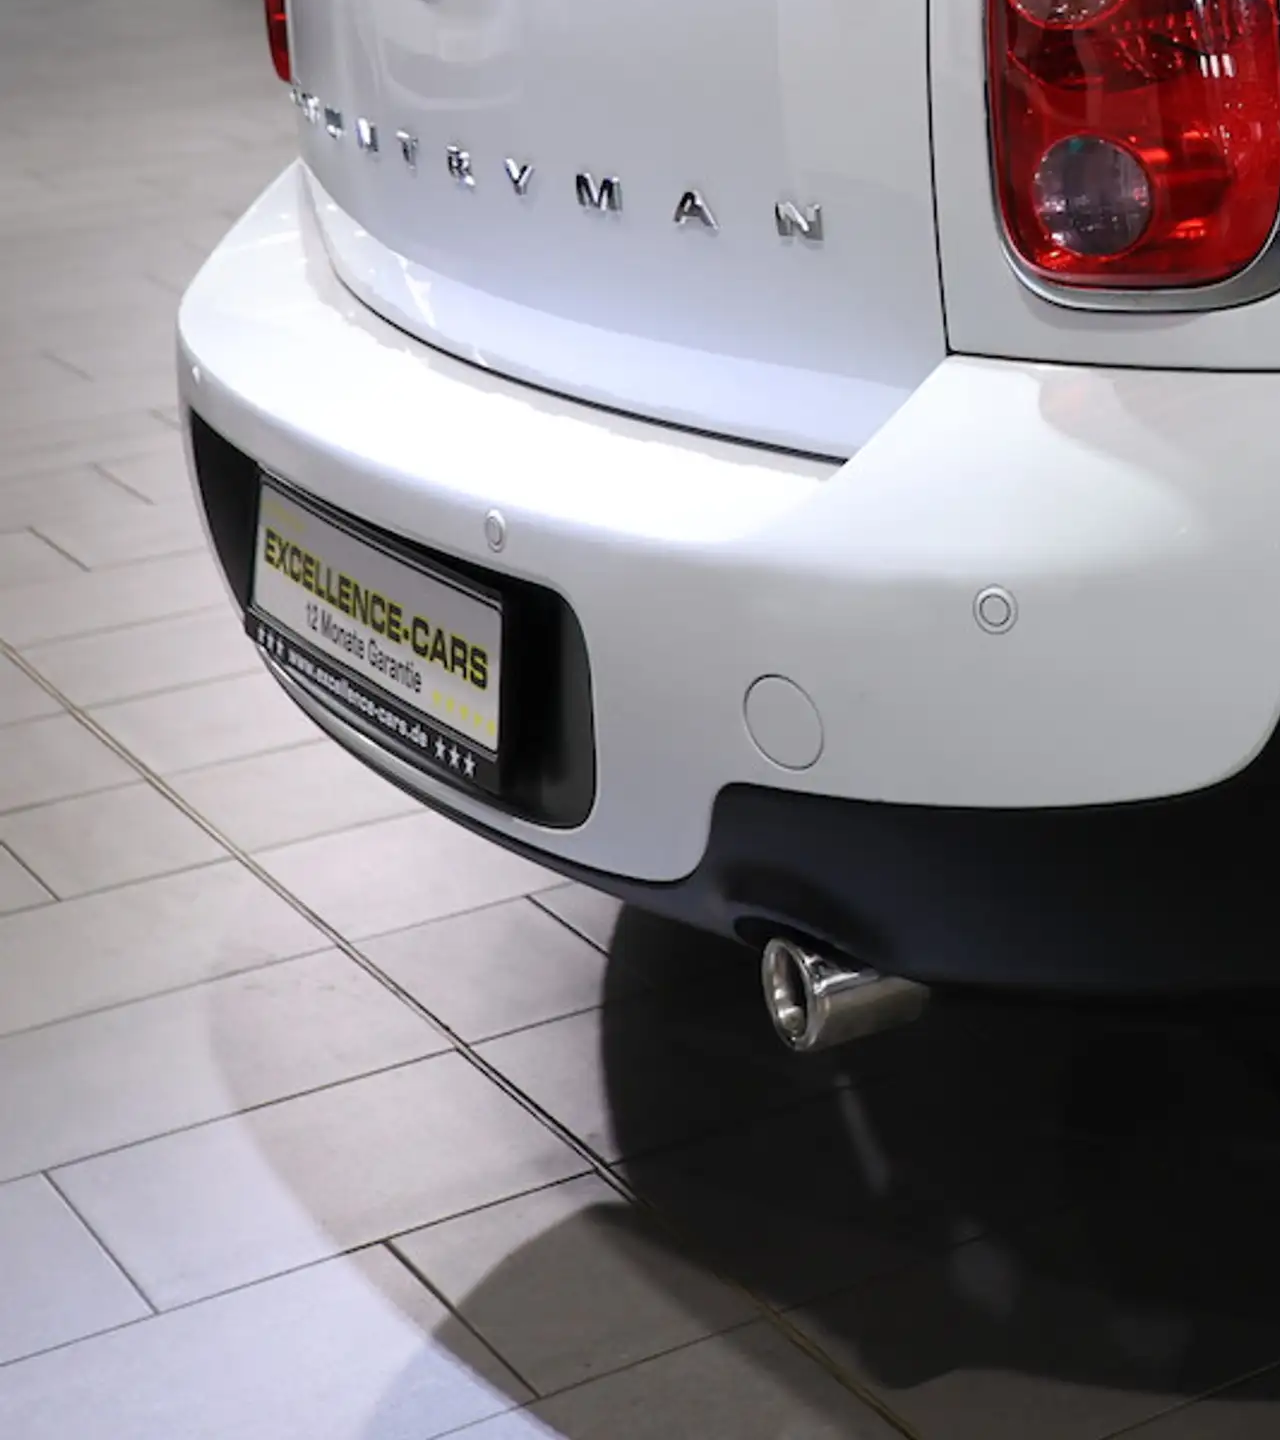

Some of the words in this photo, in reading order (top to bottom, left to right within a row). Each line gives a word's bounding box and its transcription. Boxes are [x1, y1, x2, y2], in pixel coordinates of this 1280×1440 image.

[306, 601, 319, 632] 12
[321, 612, 365, 659] Monate
[368, 638, 422, 692] Garantie
